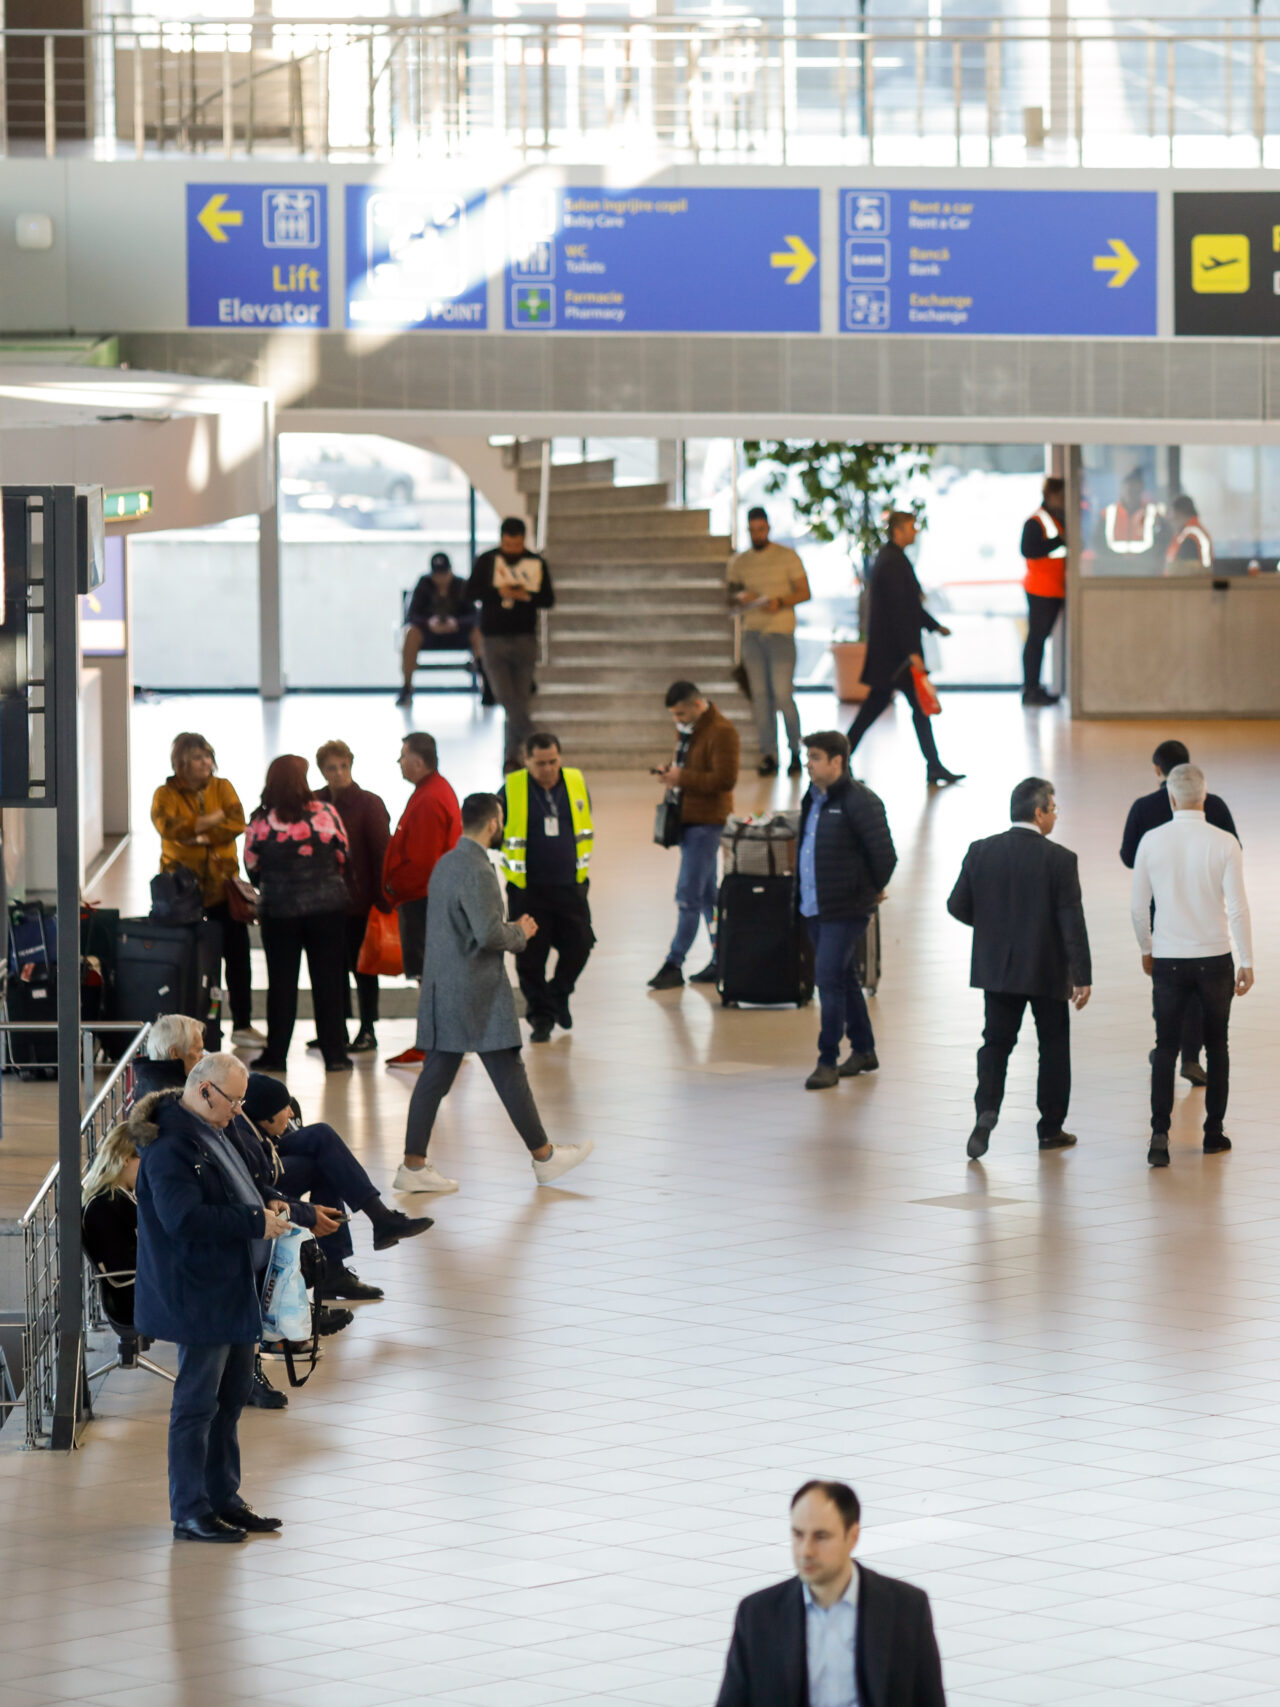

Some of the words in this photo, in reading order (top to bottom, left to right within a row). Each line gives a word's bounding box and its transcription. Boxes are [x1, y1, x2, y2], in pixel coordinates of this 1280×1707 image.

[655, 198, 687, 214] copil
[909, 200, 940, 213] Rent
[942, 204, 951, 213] a
[953, 204, 973, 213] car
[564, 214, 594, 229] Baby
[595, 214, 625, 227] Care
[909, 216, 938, 229] Rent
[939, 220, 948, 229] a
[949, 216, 970, 229] Car
[564, 244, 588, 258] WC
[564, 261, 606, 274] Toilets
[909, 263, 940, 276] Bank
[272, 265, 320, 292] Lift
[564, 290, 624, 304] Farmacie
[909, 293, 973, 310] Exchange
[218, 299, 321, 323] Elevator
[430, 303, 484, 322] POINT
[564, 306, 626, 322] Pharmacy
[909, 309, 968, 325] Exchange
